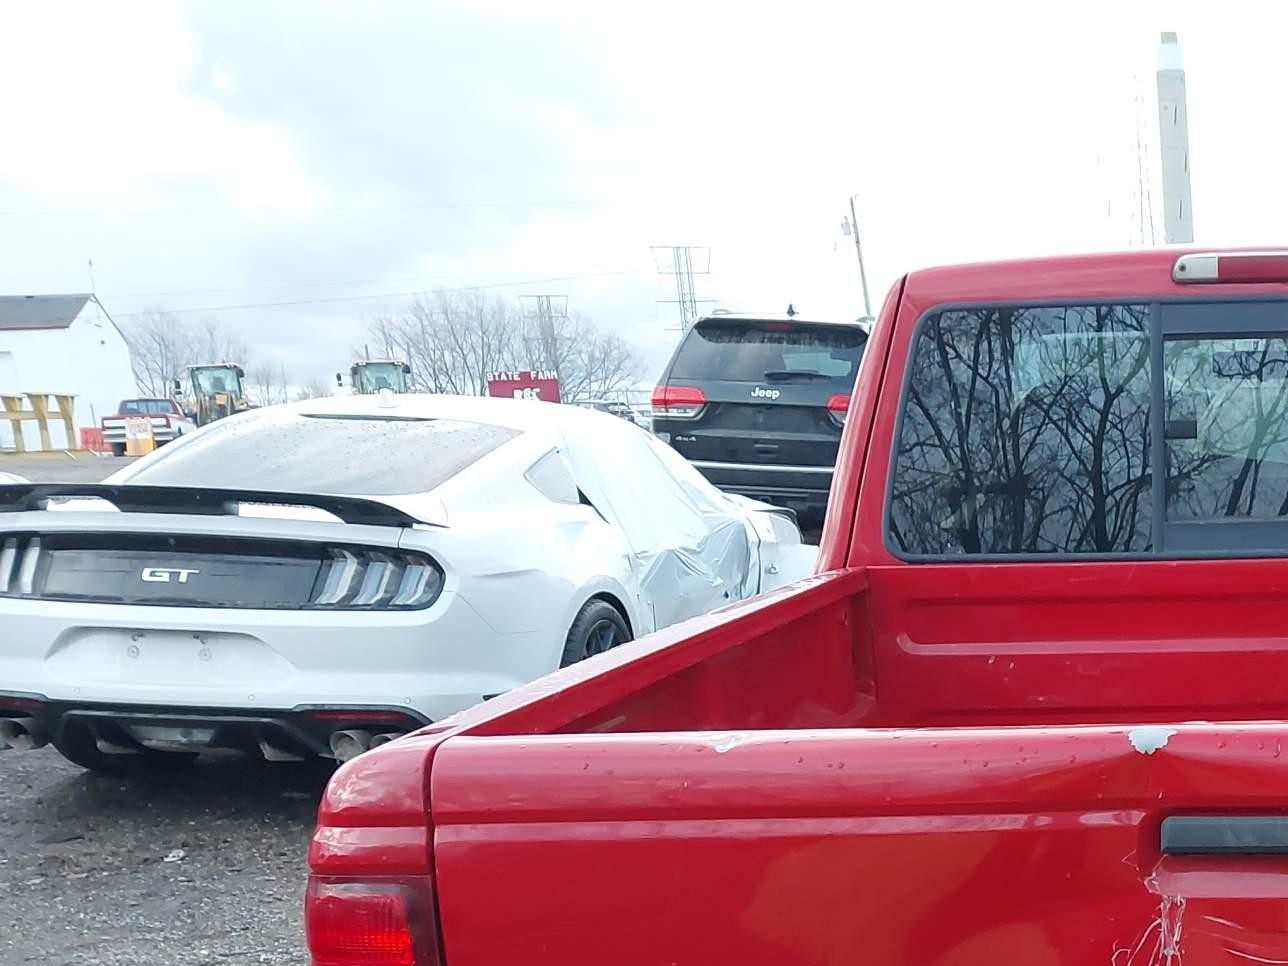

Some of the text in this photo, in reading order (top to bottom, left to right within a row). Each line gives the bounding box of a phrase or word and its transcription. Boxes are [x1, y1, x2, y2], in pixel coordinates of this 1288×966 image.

[487, 369, 558, 382] STATE FARM
[751, 387, 780, 401] Jeep
[141, 567, 200, 584] GT
